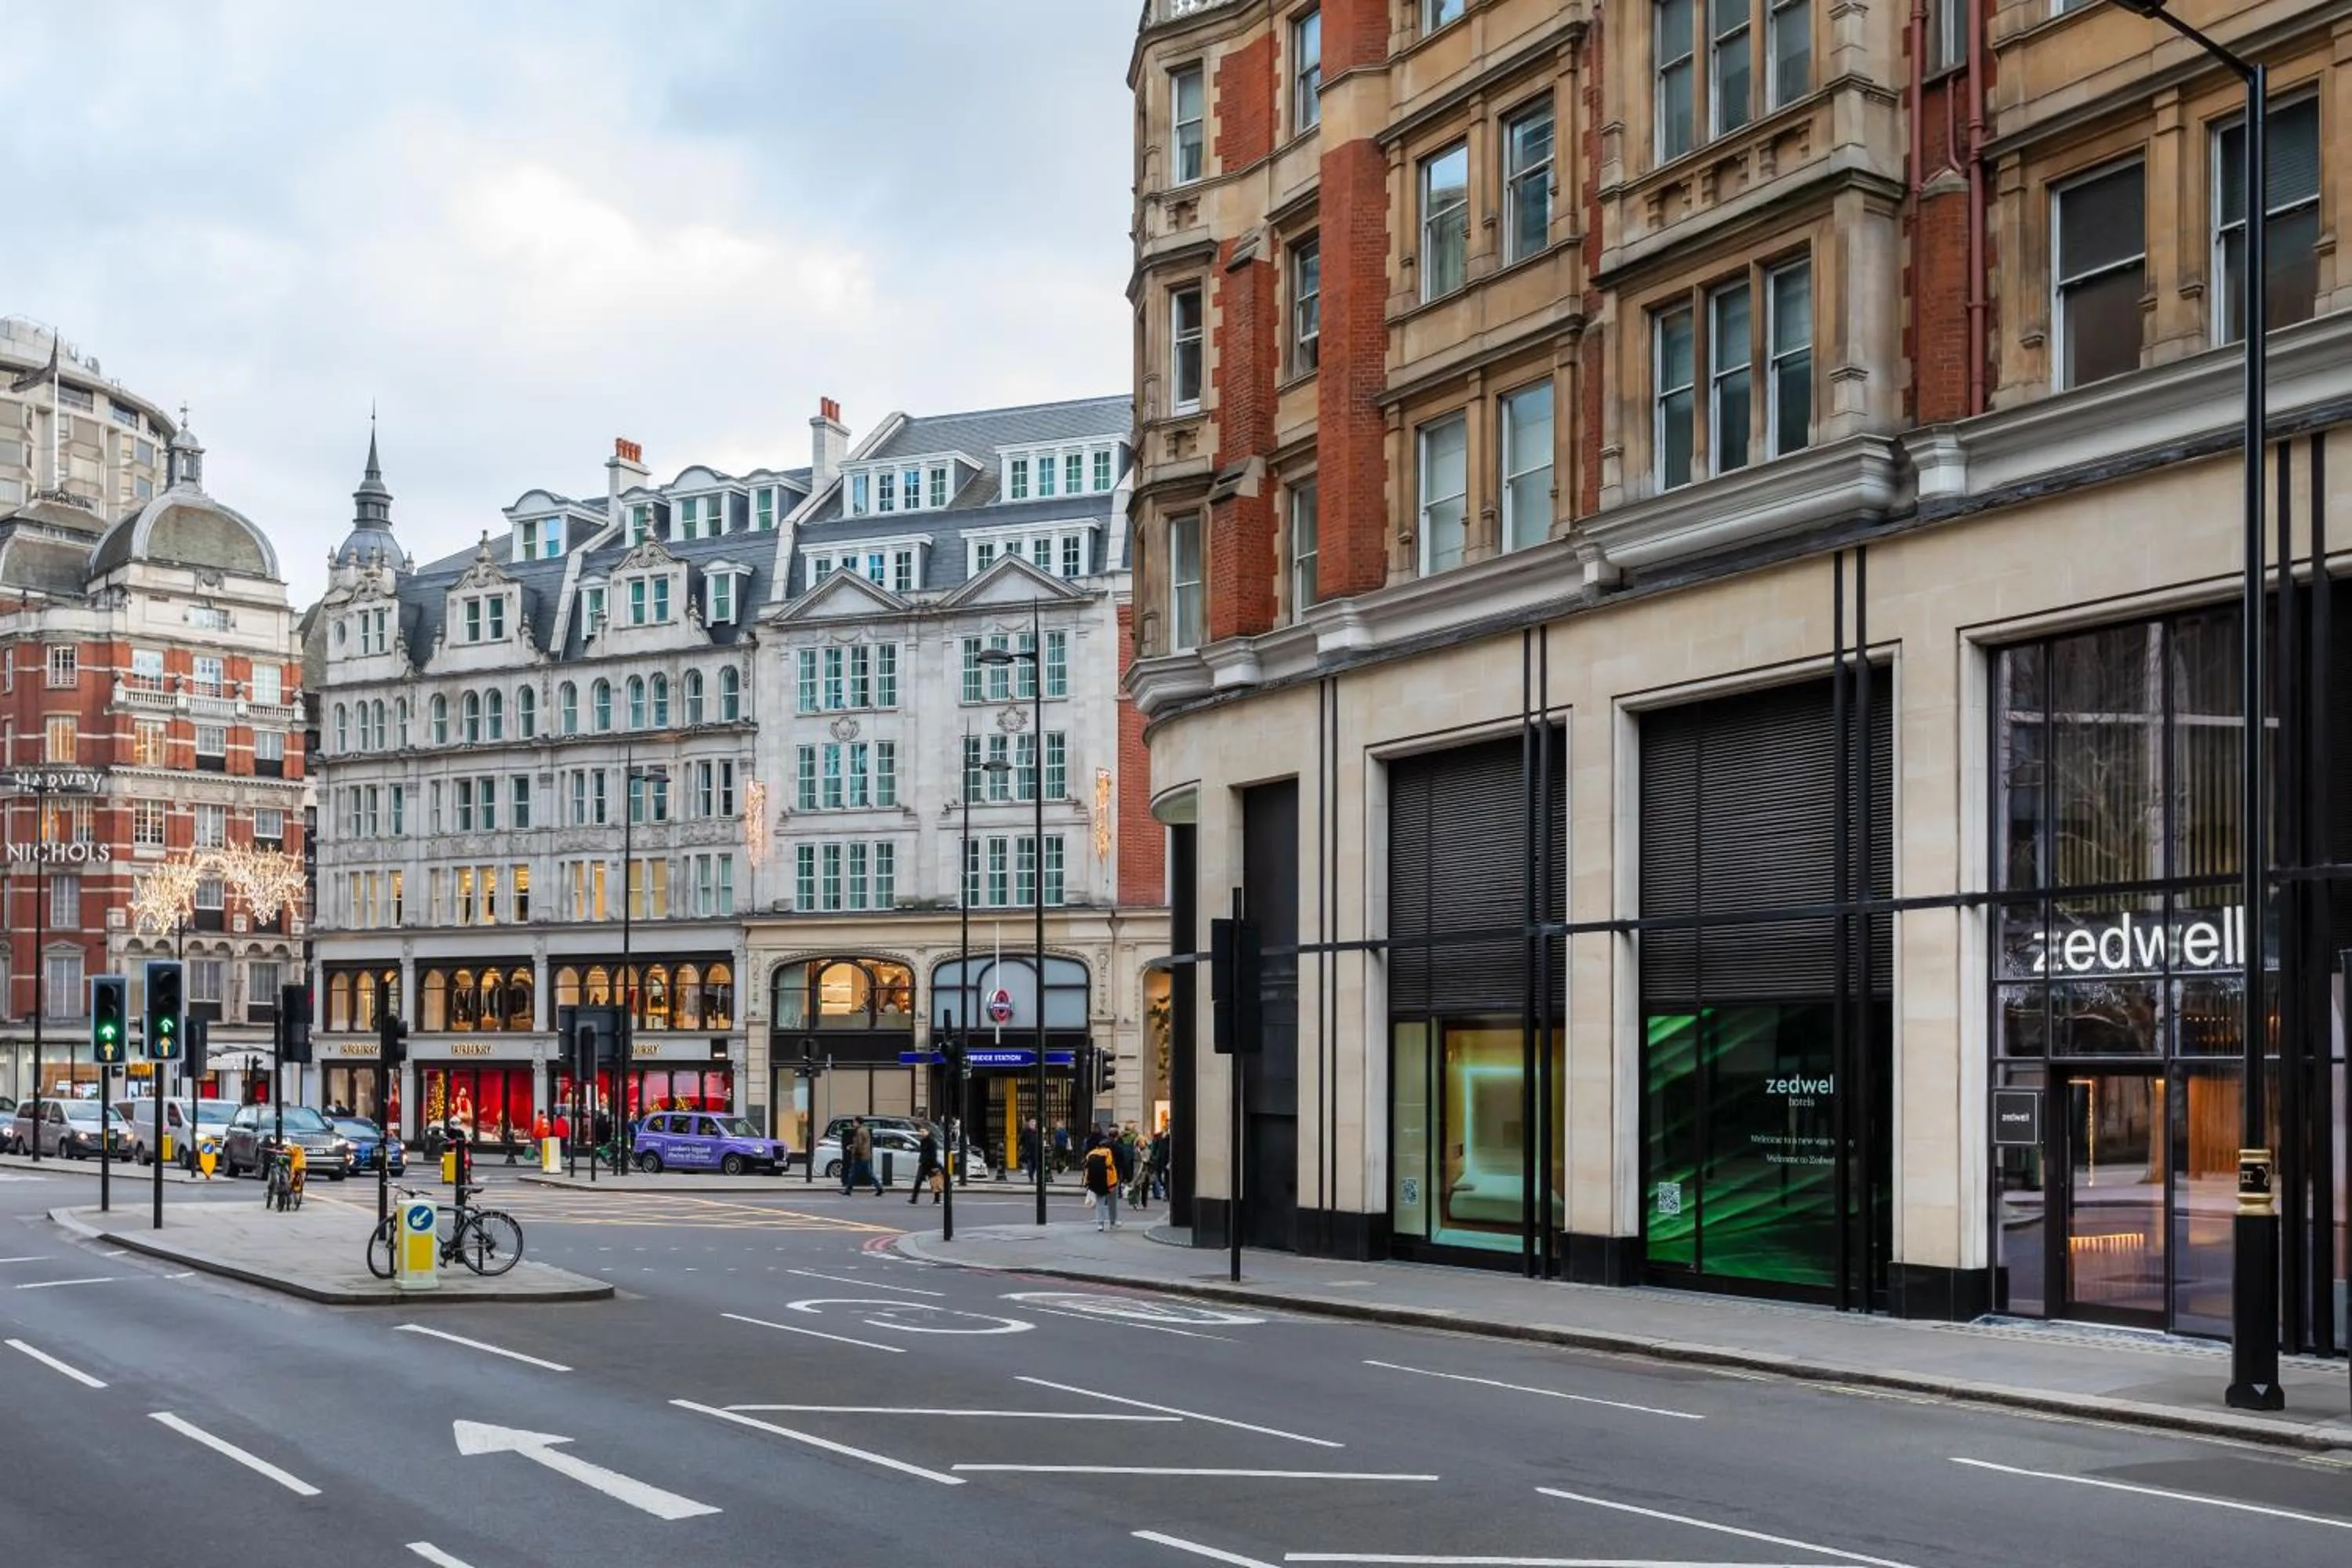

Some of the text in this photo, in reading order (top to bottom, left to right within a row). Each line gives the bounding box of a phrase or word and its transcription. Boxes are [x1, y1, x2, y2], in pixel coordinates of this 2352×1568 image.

[15, 772, 103, 793] HARVEY
[5, 842, 110, 862] NICHOLS
[2032, 905, 2245, 971] zedwell
[1765, 1073, 1835, 1094] zedwel
[1788, 1096, 1816, 1107] hotels
[2002, 1112, 2030, 1123] zedwell
